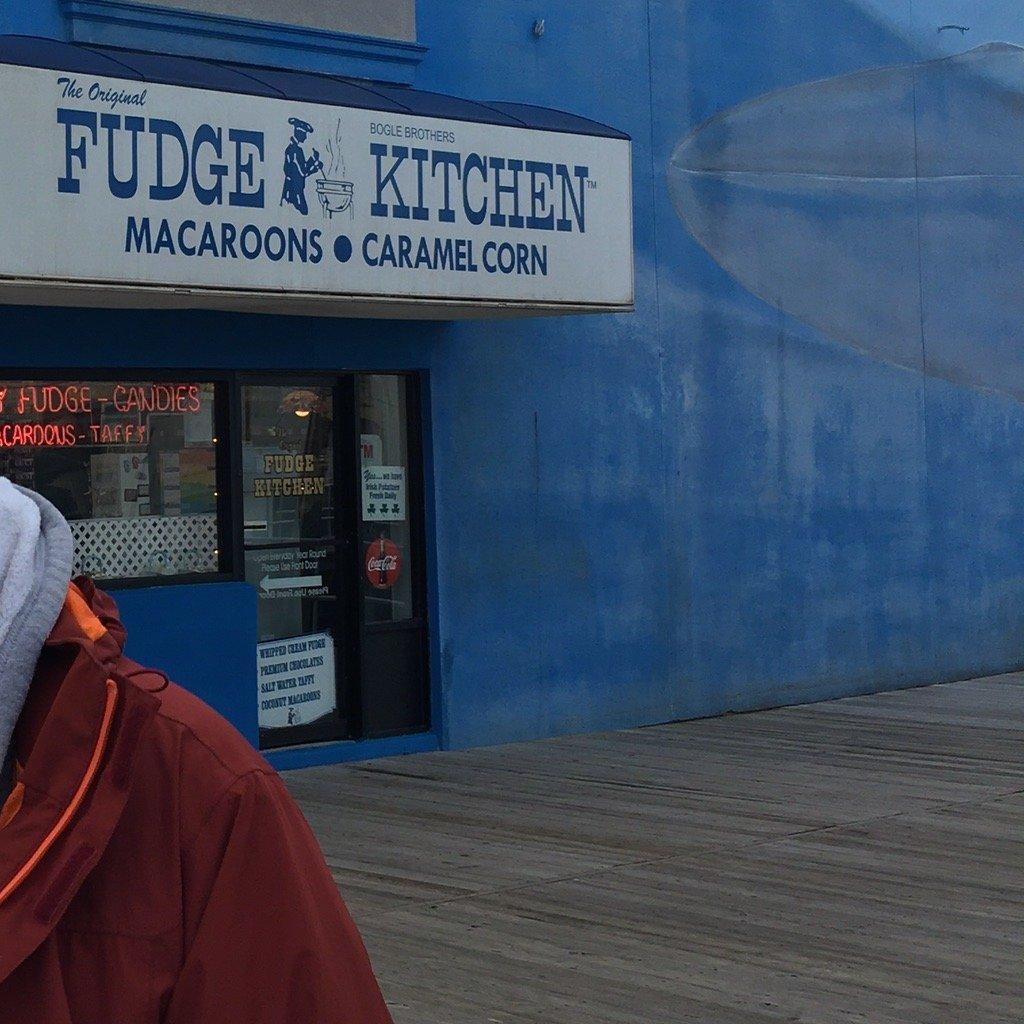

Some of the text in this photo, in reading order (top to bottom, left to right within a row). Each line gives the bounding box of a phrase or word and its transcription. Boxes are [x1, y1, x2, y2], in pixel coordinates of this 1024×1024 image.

[57, 77, 147, 110] The Original
[370, 122, 455, 143] BOGLE BROTHERS
[57, 108, 265, 208] FUDGE
[370, 143, 589, 233] KITCHEN
[125, 216, 547, 276] MACAROONS CARAMEL CORN
[18, 385, 91, 414] FUDGE
[113, 385, 200, 413] CANDIES
[90, 424, 145, 444] TAFFY
[264, 454, 314, 473] FUDGE
[254, 477, 324, 497] KITCHEN
[259, 638, 326, 658] WHIPPED CREAM FUDGE
[260, 656, 324, 676] PREMIUM CHOCOLATES
[260, 674, 315, 693] SALT WATER TAFFY
[261, 690, 321, 710] COCONUT MACAROONS
